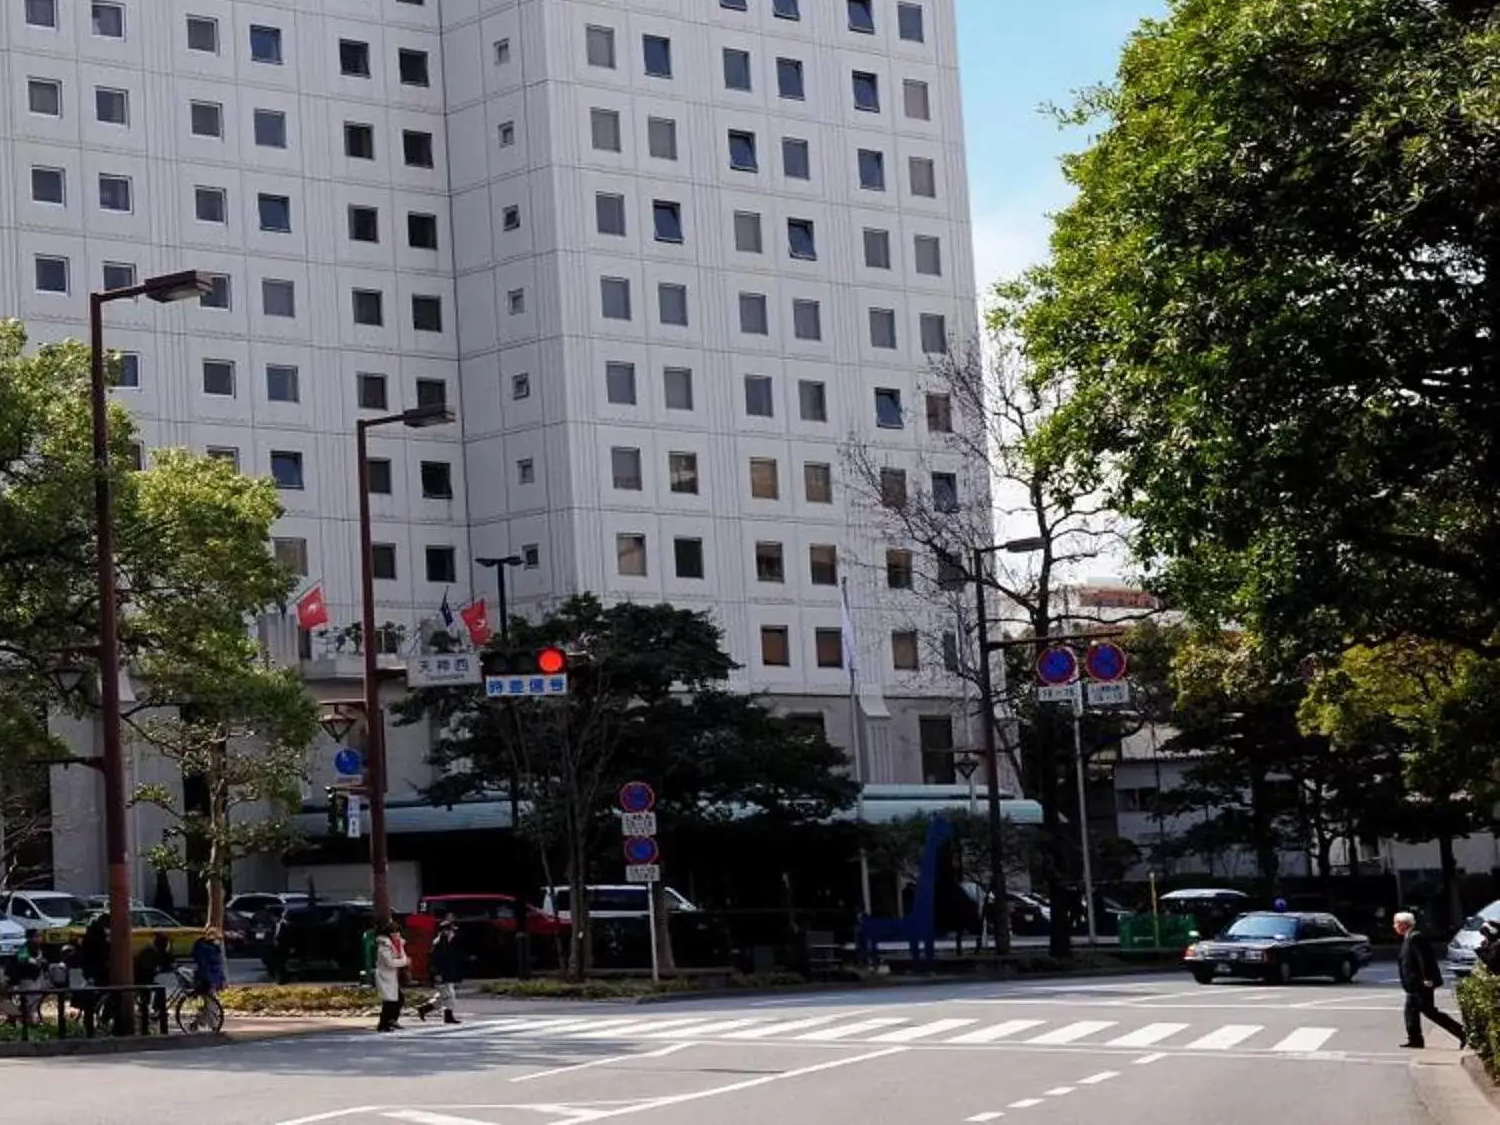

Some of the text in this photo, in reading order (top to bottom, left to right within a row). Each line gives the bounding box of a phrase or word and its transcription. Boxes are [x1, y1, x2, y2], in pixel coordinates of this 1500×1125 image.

[418, 658, 469, 674] 天神西
[489, 678, 564, 695] 時差信号
